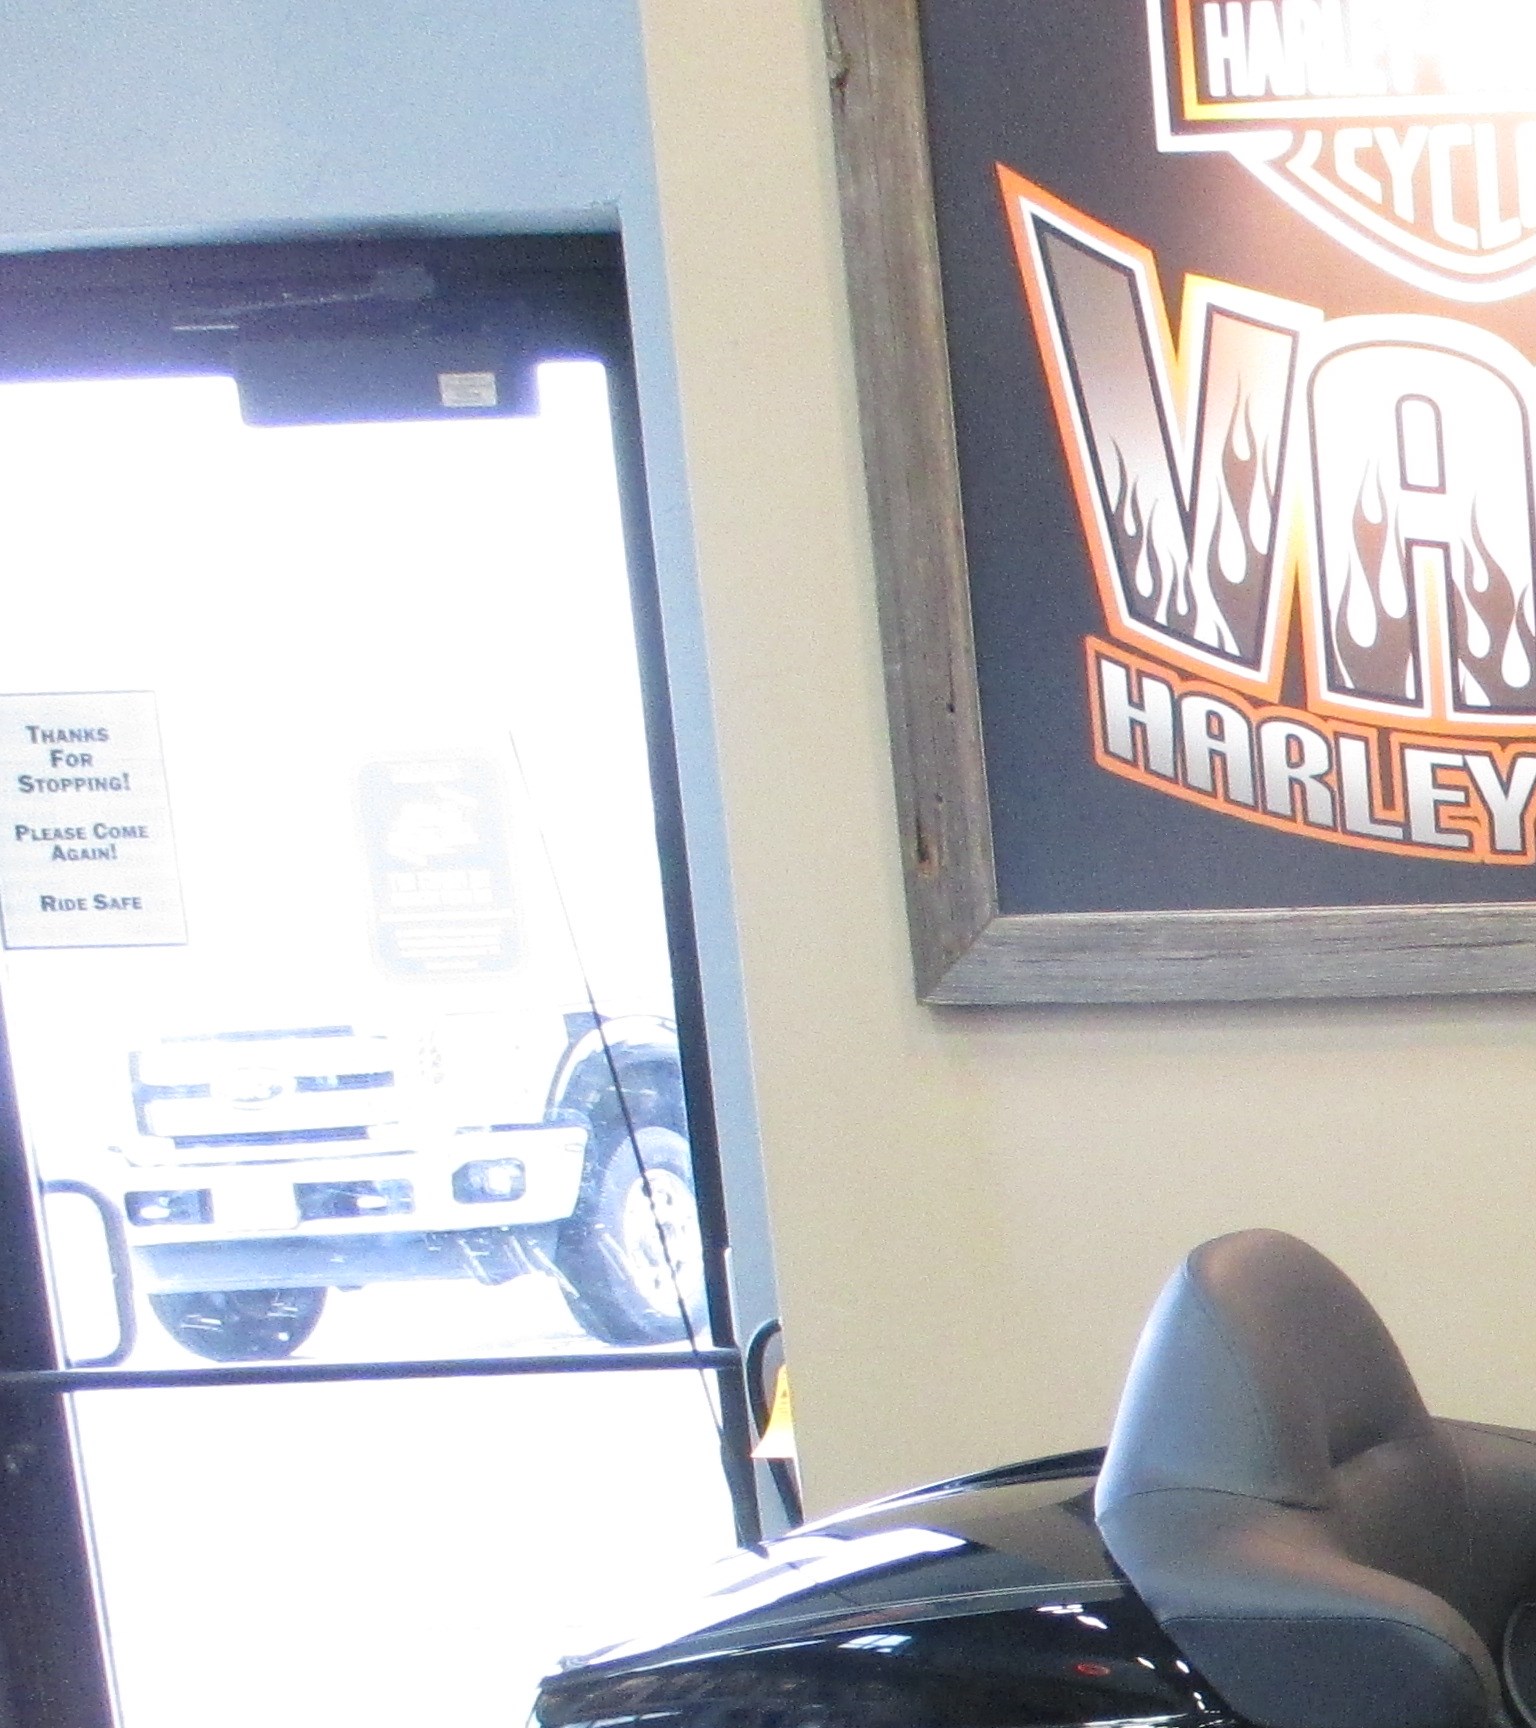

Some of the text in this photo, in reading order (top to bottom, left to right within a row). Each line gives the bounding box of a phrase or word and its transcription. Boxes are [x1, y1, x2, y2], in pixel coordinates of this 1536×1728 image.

[26, 725, 110, 745] THANKS
[50, 750, 93, 768] FOR
[18, 773, 131, 793] STOPPING!
[15, 823, 149, 842] PLEASE COME
[52, 844, 117, 861] AGAIN!
[40, 894, 143, 912] RIDE SAFE
